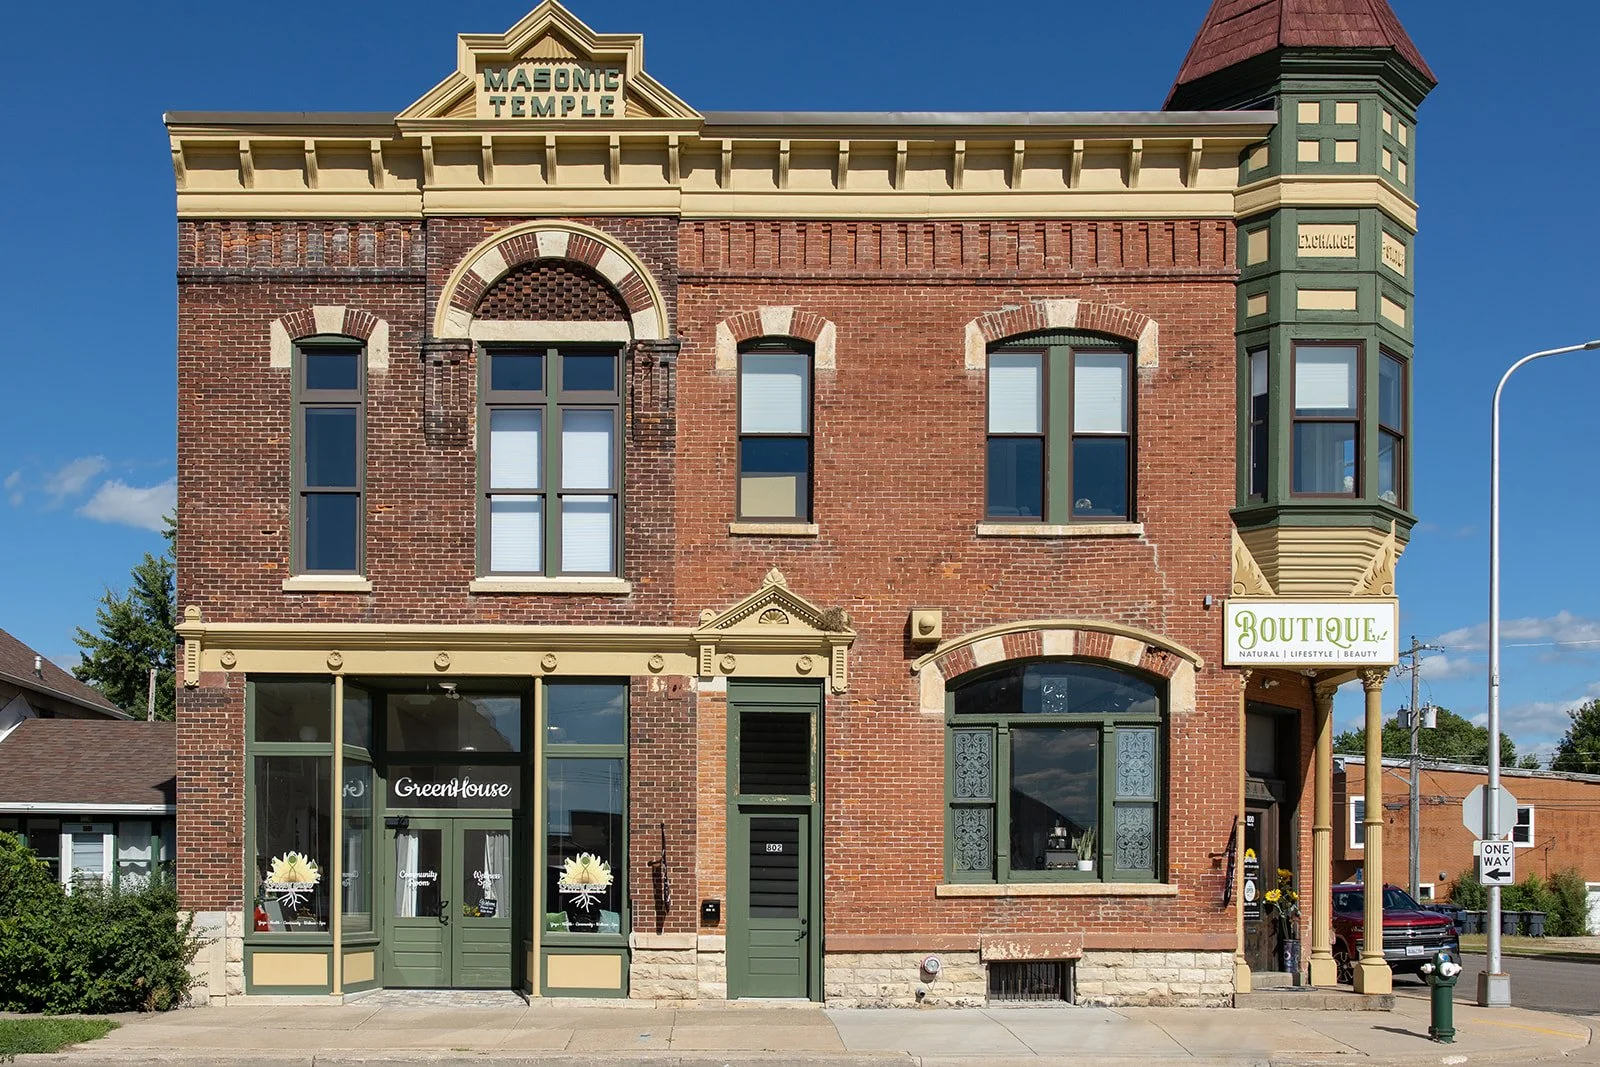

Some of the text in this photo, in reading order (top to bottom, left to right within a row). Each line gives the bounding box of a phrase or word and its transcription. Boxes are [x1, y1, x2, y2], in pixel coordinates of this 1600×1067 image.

[484, 68, 619, 92] MASONIC
[489, 95, 615, 117] TEMPLE
[1298, 233, 1354, 249] EXCHANGE
[1239, 650, 1378, 658] NATURAL LIFESTYLE BEAUTY
[394, 776, 512, 799] GreenHouse
[766, 844, 783, 852] 802
[1484, 844, 1510, 854] ONE
[1484, 857, 1511, 866] WAY
